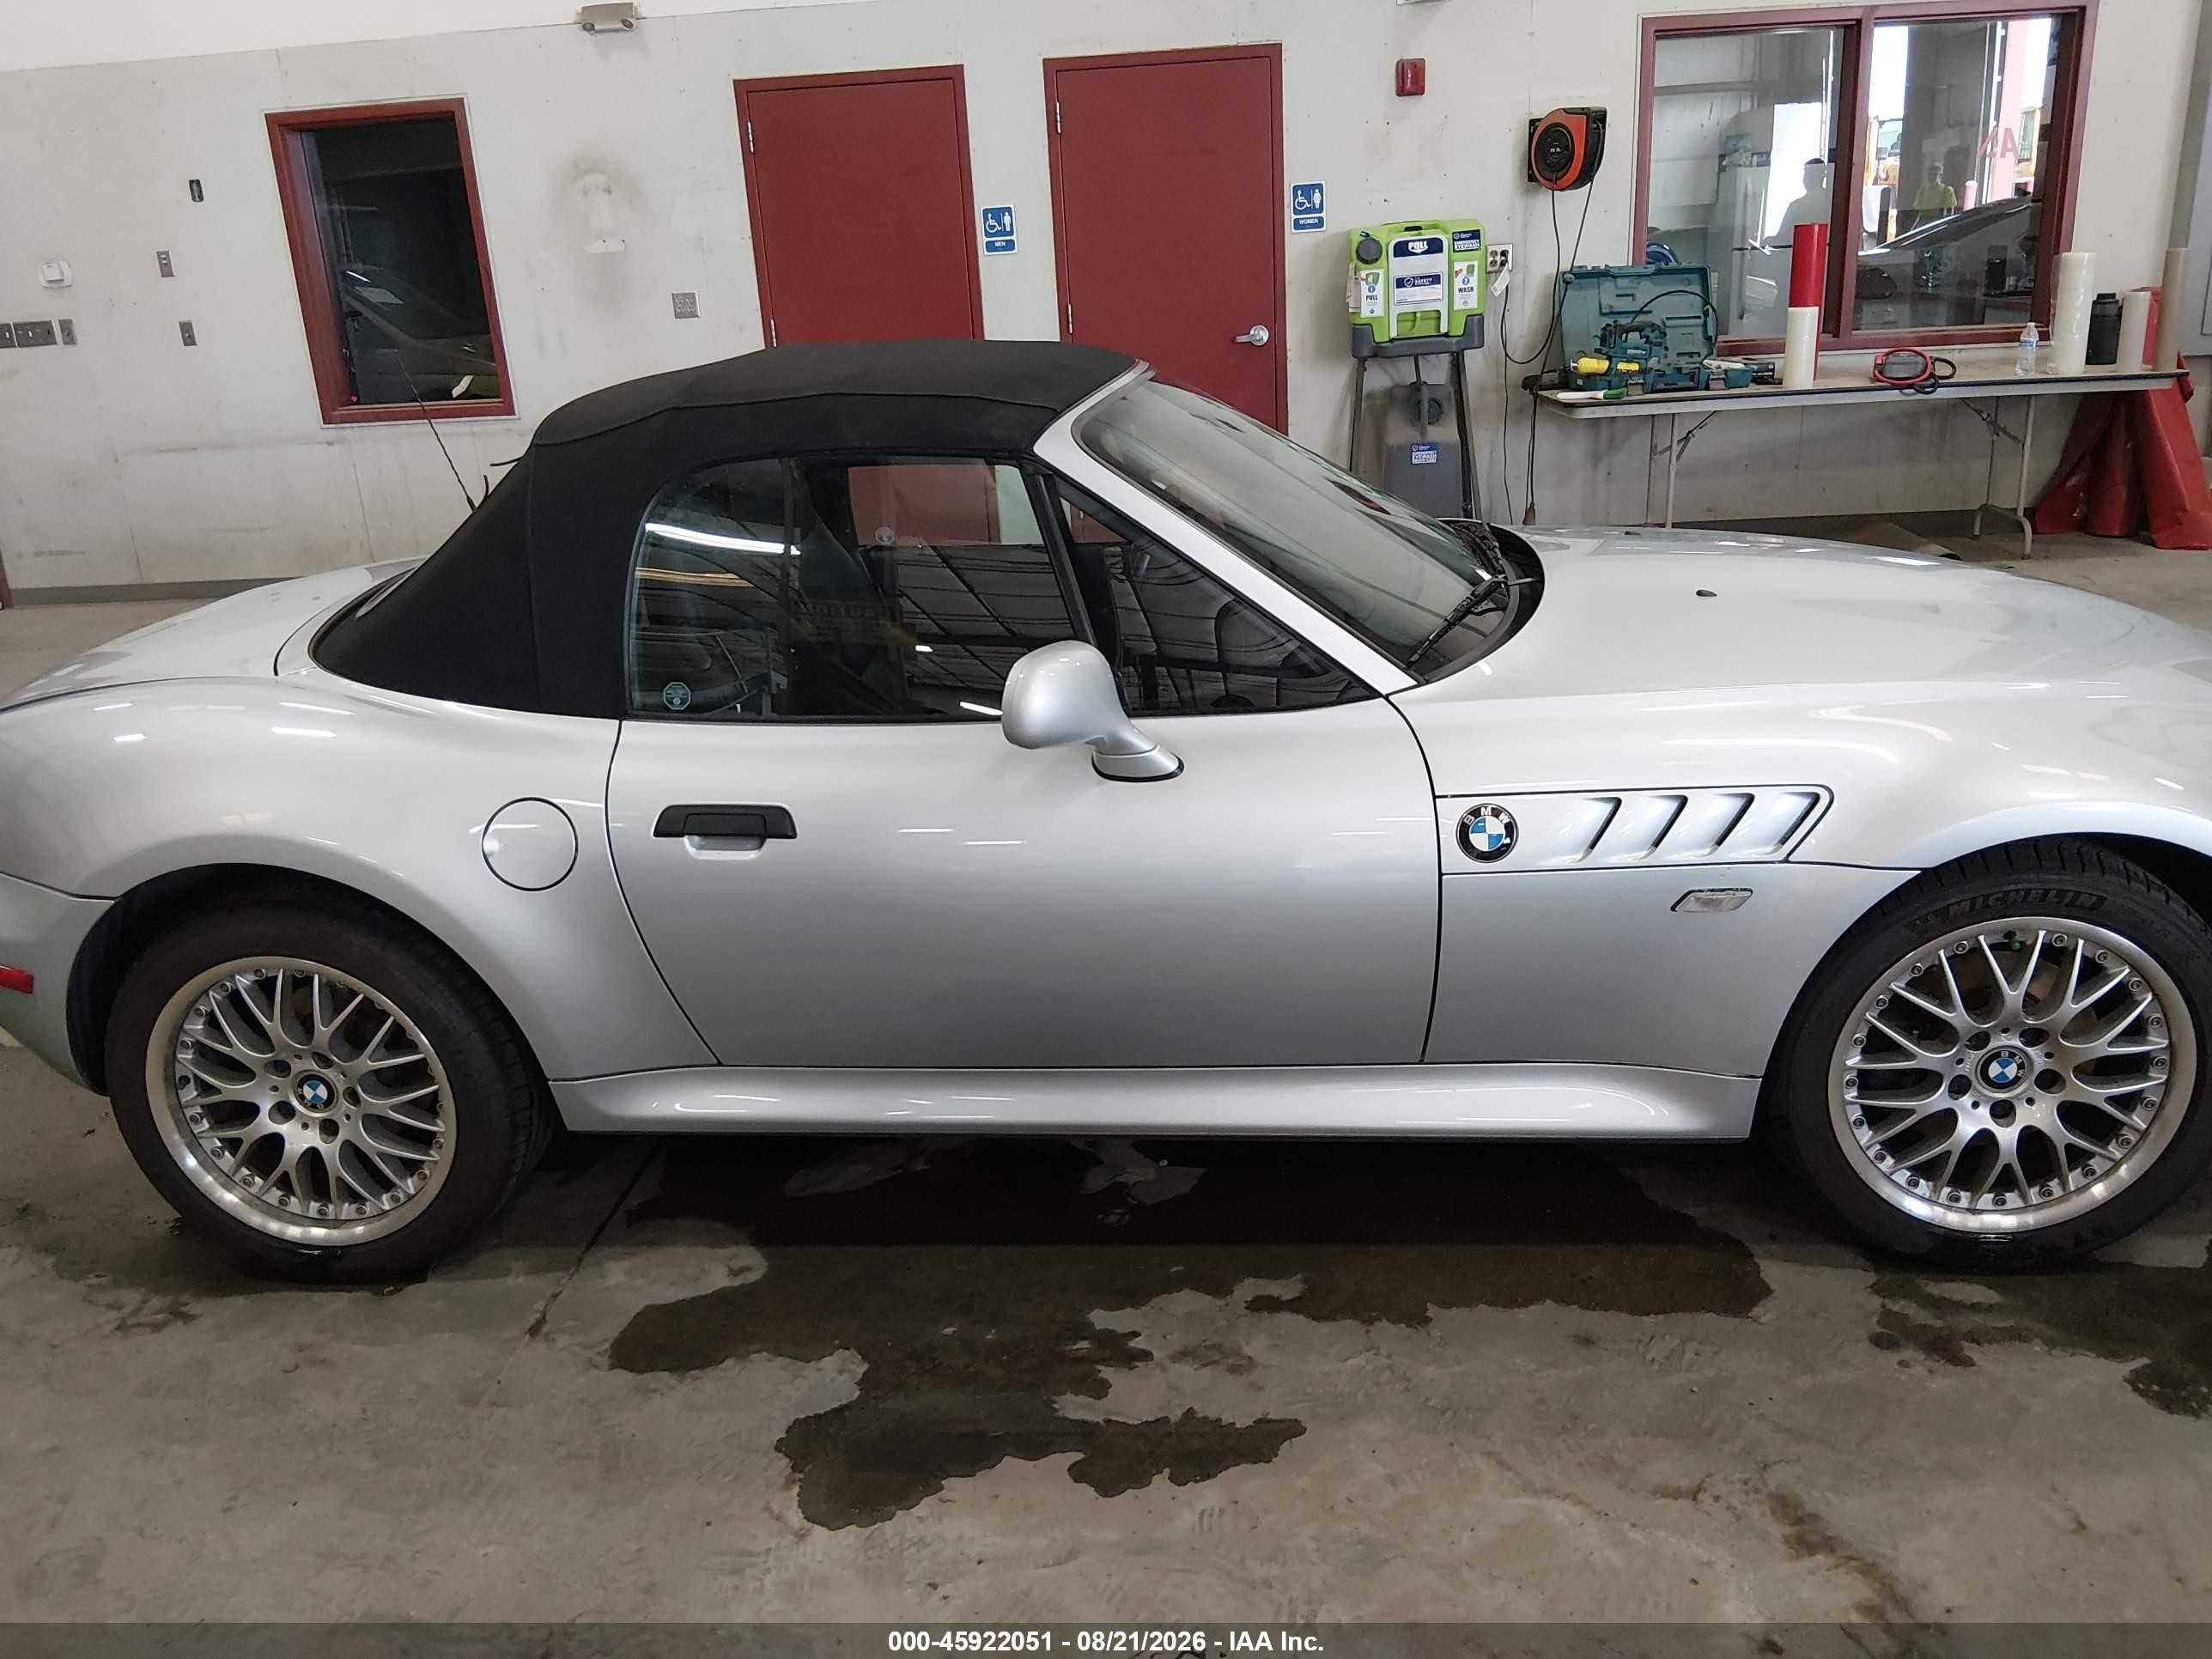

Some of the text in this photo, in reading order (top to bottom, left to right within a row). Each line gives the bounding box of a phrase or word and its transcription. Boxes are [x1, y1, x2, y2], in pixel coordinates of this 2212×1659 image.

[1408, 240, 1429, 251] PULL
[1463, 806, 1510, 825] BMW
[1946, 886, 2109, 922] MICHELIN
[2001, 1050, 2026, 1078] BMW
